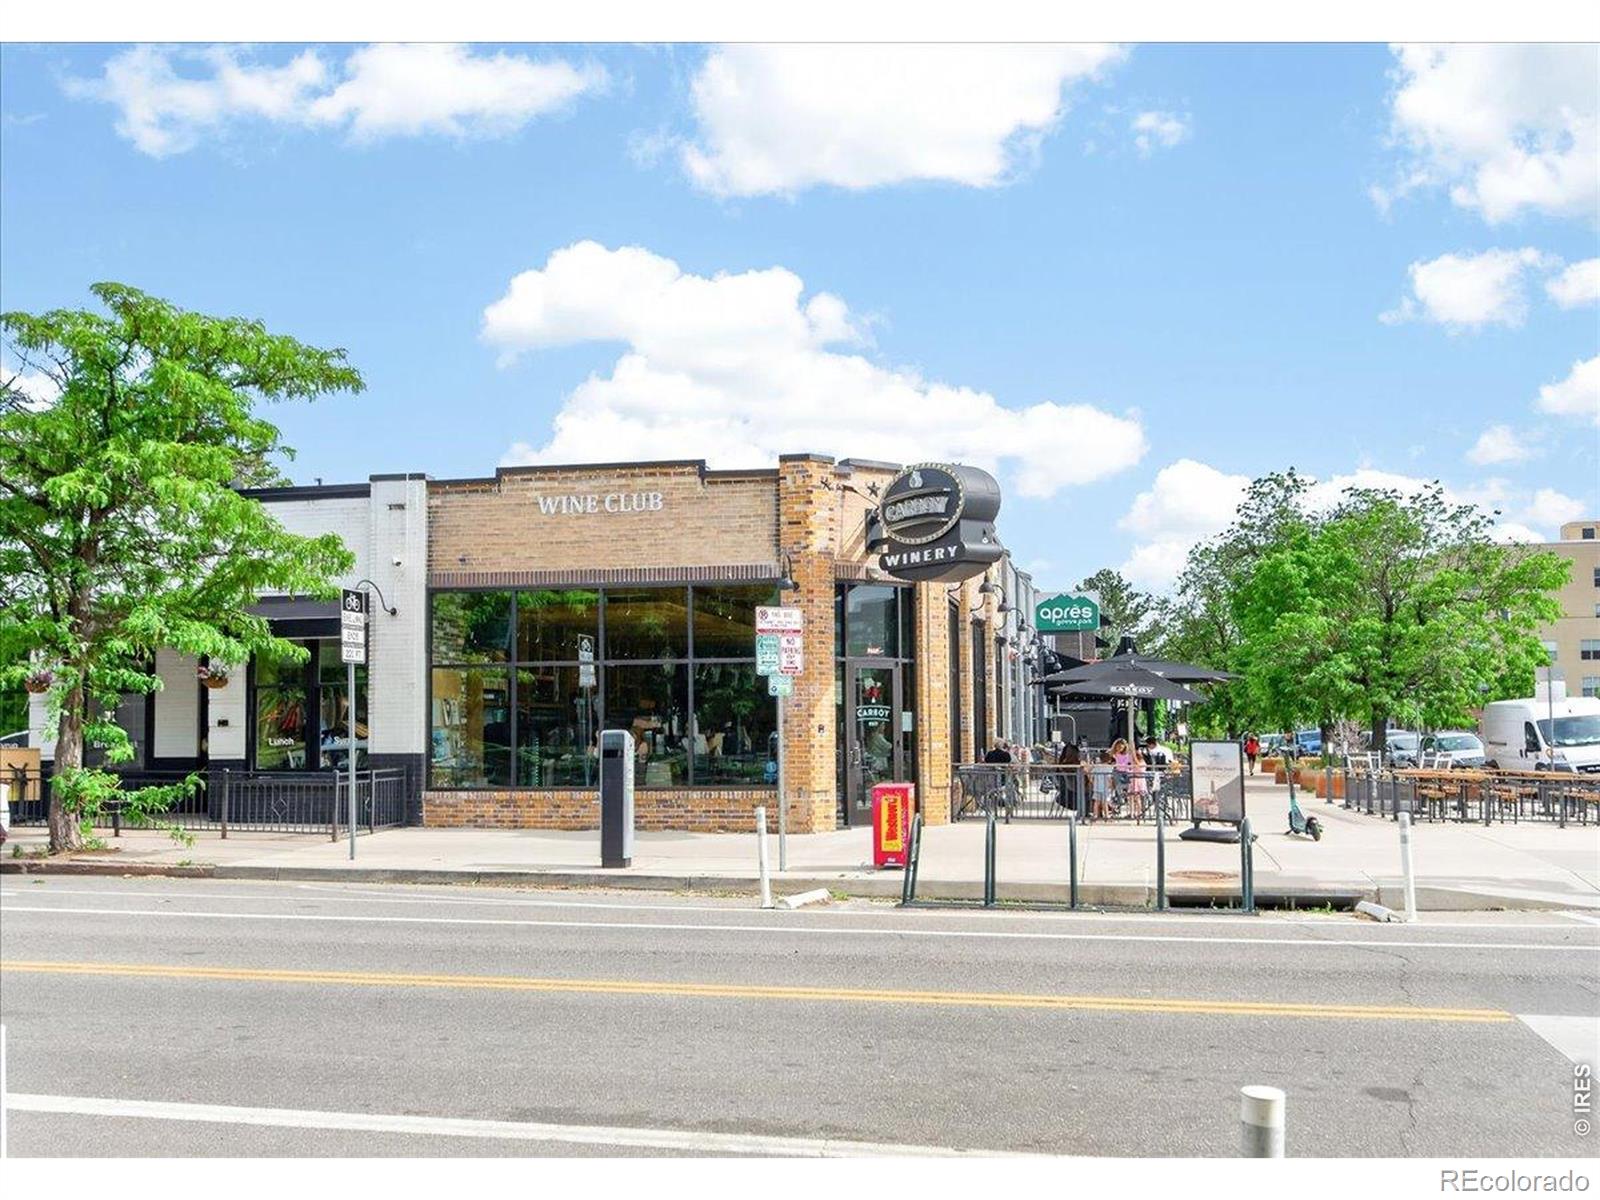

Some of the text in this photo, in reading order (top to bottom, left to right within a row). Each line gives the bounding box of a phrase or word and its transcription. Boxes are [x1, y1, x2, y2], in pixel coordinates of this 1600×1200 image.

[538, 491, 664, 515] WINE CLUB
[885, 545, 958, 567] WINERY
[856, 708, 890, 718] CARBOY
[268, 737, 295, 746] Lunch
